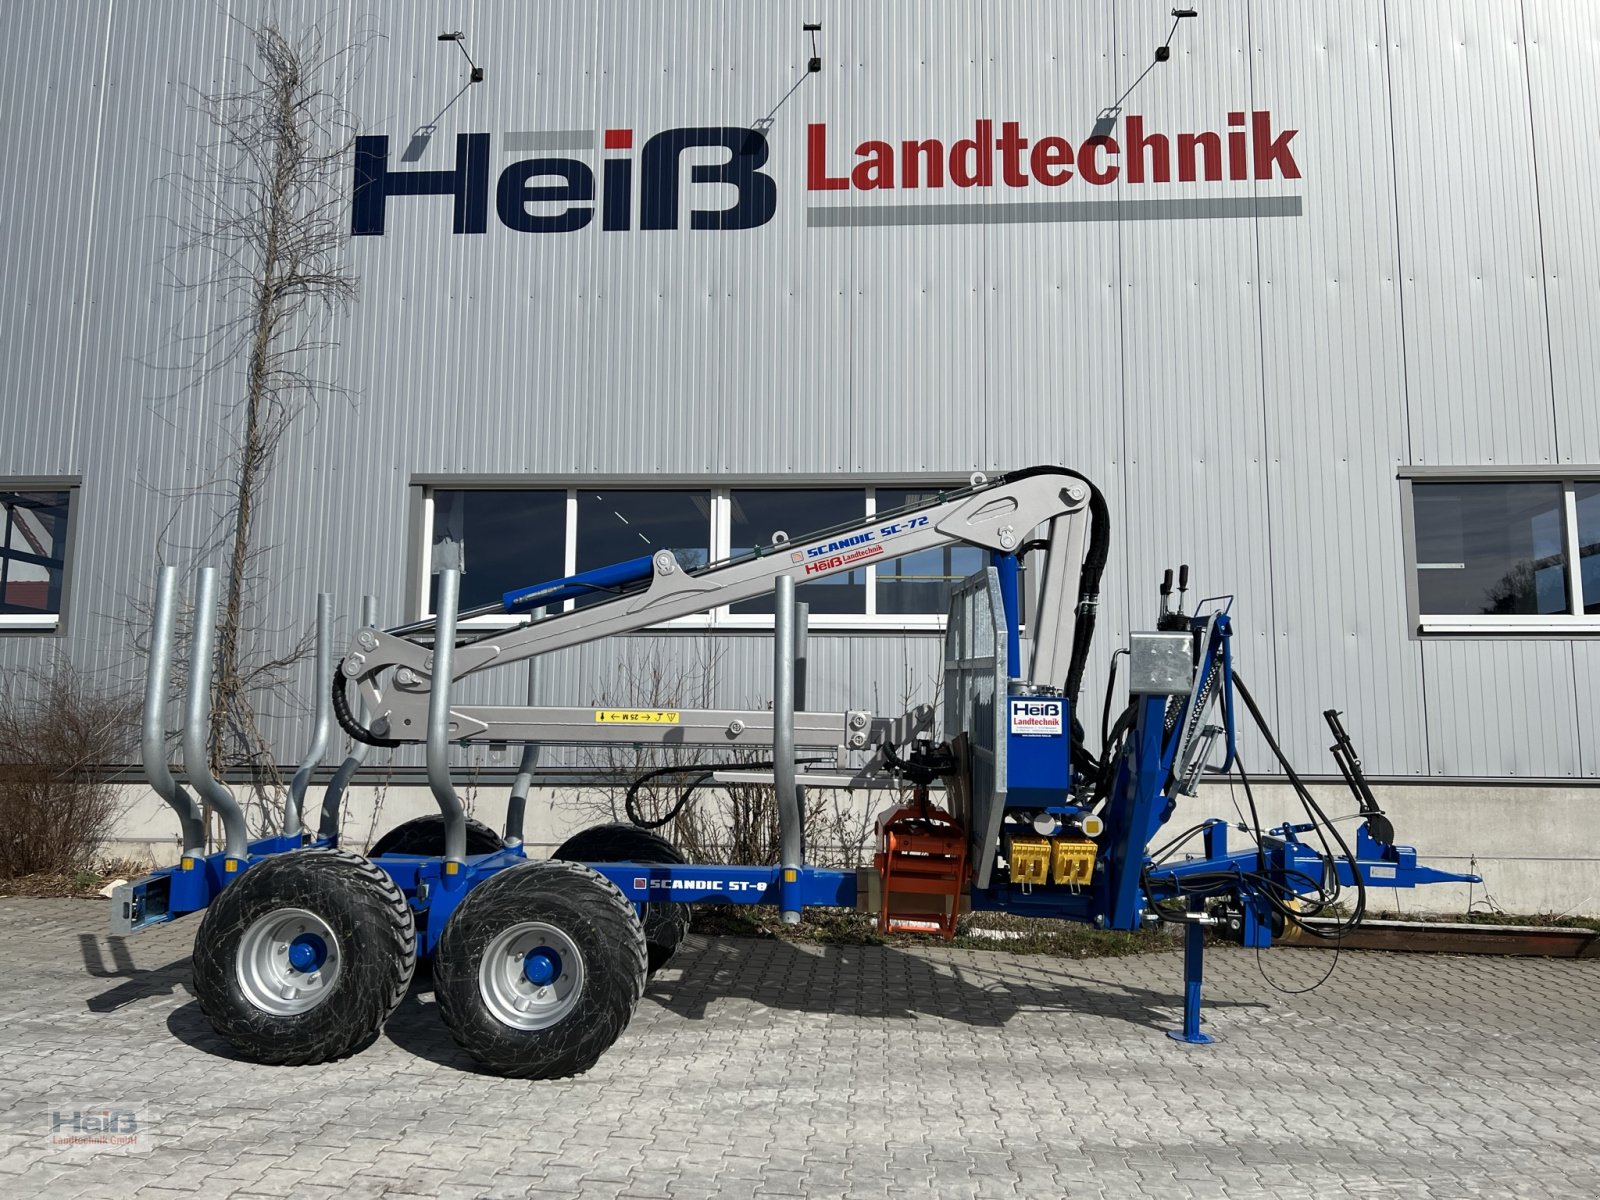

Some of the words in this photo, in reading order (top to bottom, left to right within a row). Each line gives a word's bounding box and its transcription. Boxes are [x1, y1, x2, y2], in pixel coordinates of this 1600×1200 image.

[351, 126, 777, 236] Heiß
[807, 111, 1302, 191] Landtechnik
[807, 531, 876, 558] SCANDIC
[880, 516, 929, 537] SC-72
[805, 557, 843, 575] Heiß
[842, 544, 883, 561] Landtechnik
[1013, 703, 1060, 716] Heiß
[1013, 717, 1060, 726] Landtechnik
[650, 879, 723, 890] SCANDIC
[728, 881, 768, 892] ST-8
